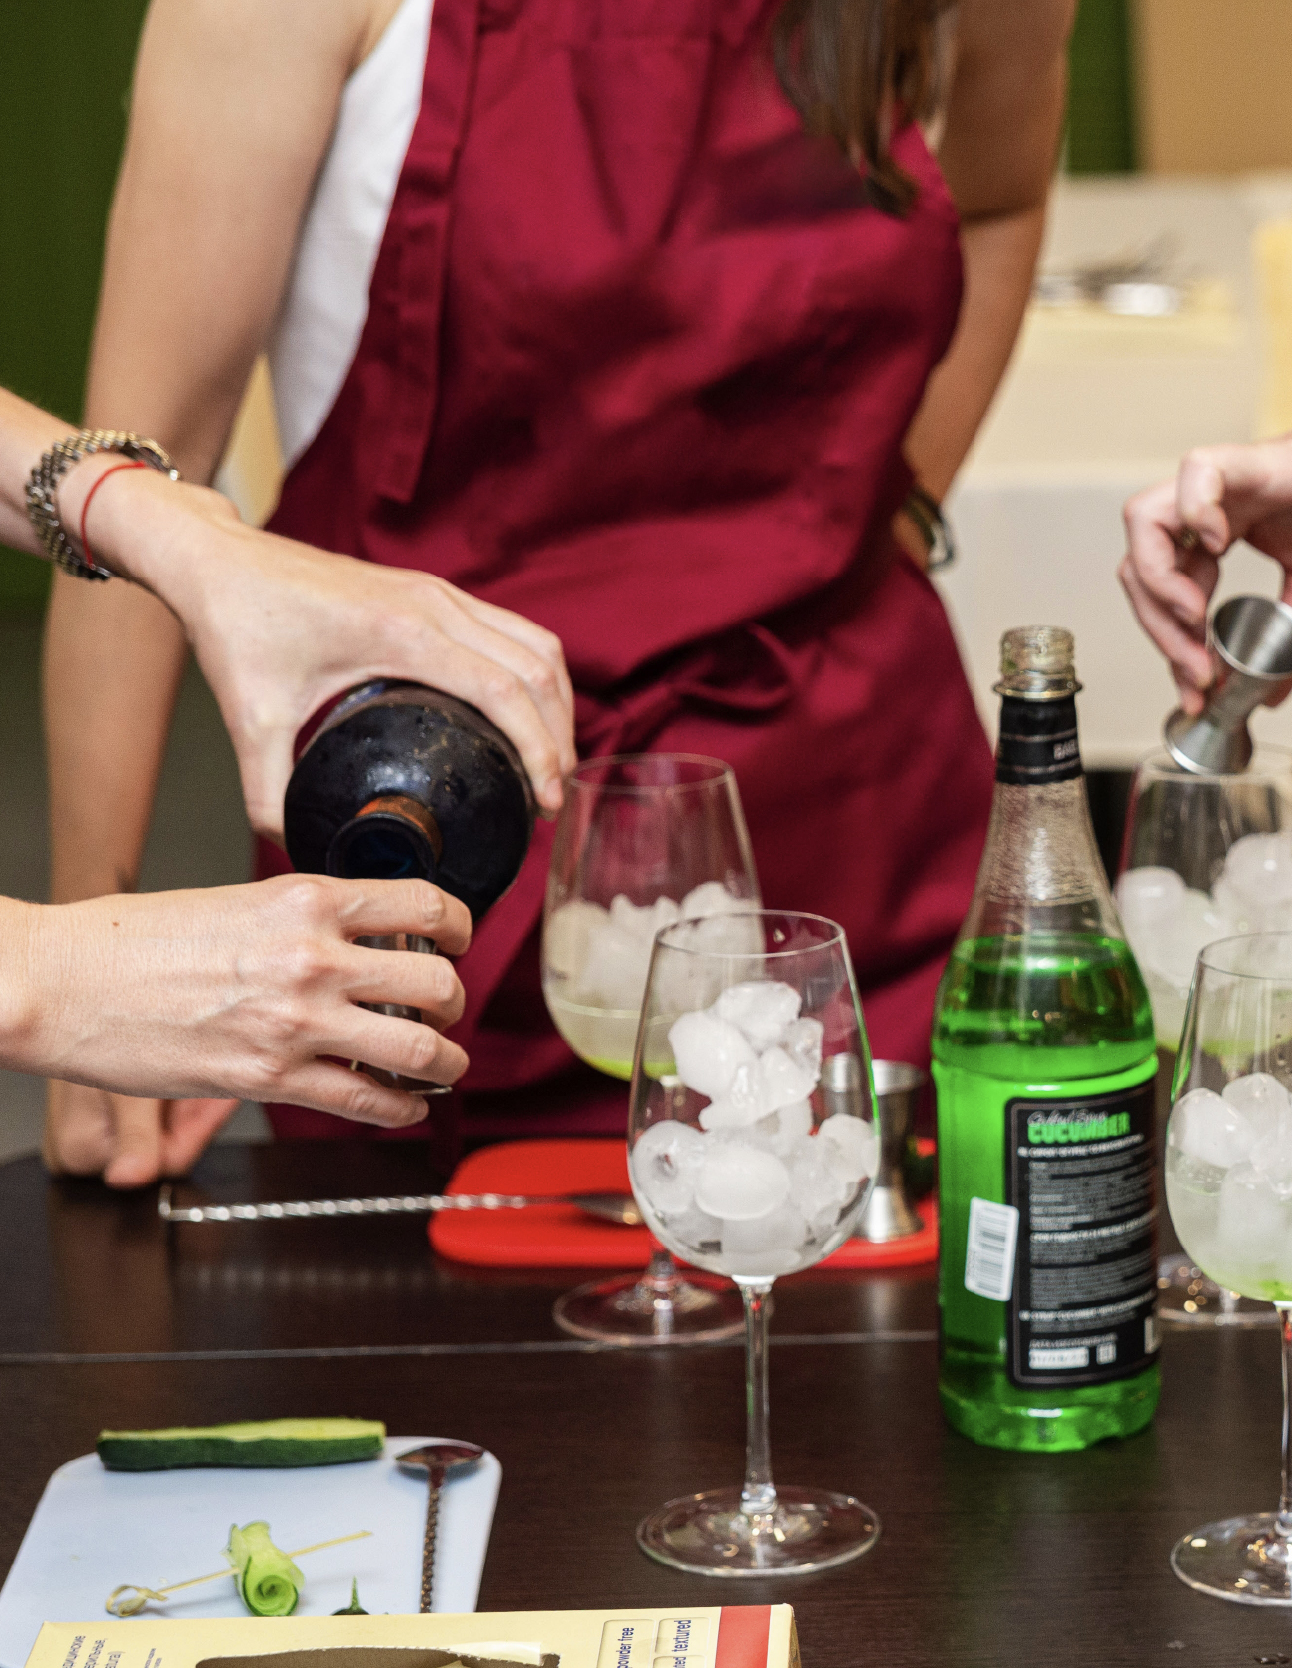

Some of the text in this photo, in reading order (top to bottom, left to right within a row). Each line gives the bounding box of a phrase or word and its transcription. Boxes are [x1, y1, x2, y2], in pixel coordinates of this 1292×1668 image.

[1028, 1112, 1130, 1144] CUCUMBER
[617, 1627, 635, 1642] free
[671, 1619, 692, 1653] textured
[62, 1636, 86, 1668] дицинские
[84, 1638, 108, 1668] ерильные,
[105, 1651, 126, 1668] atural)
[672, 1656, 687, 1668] ted
